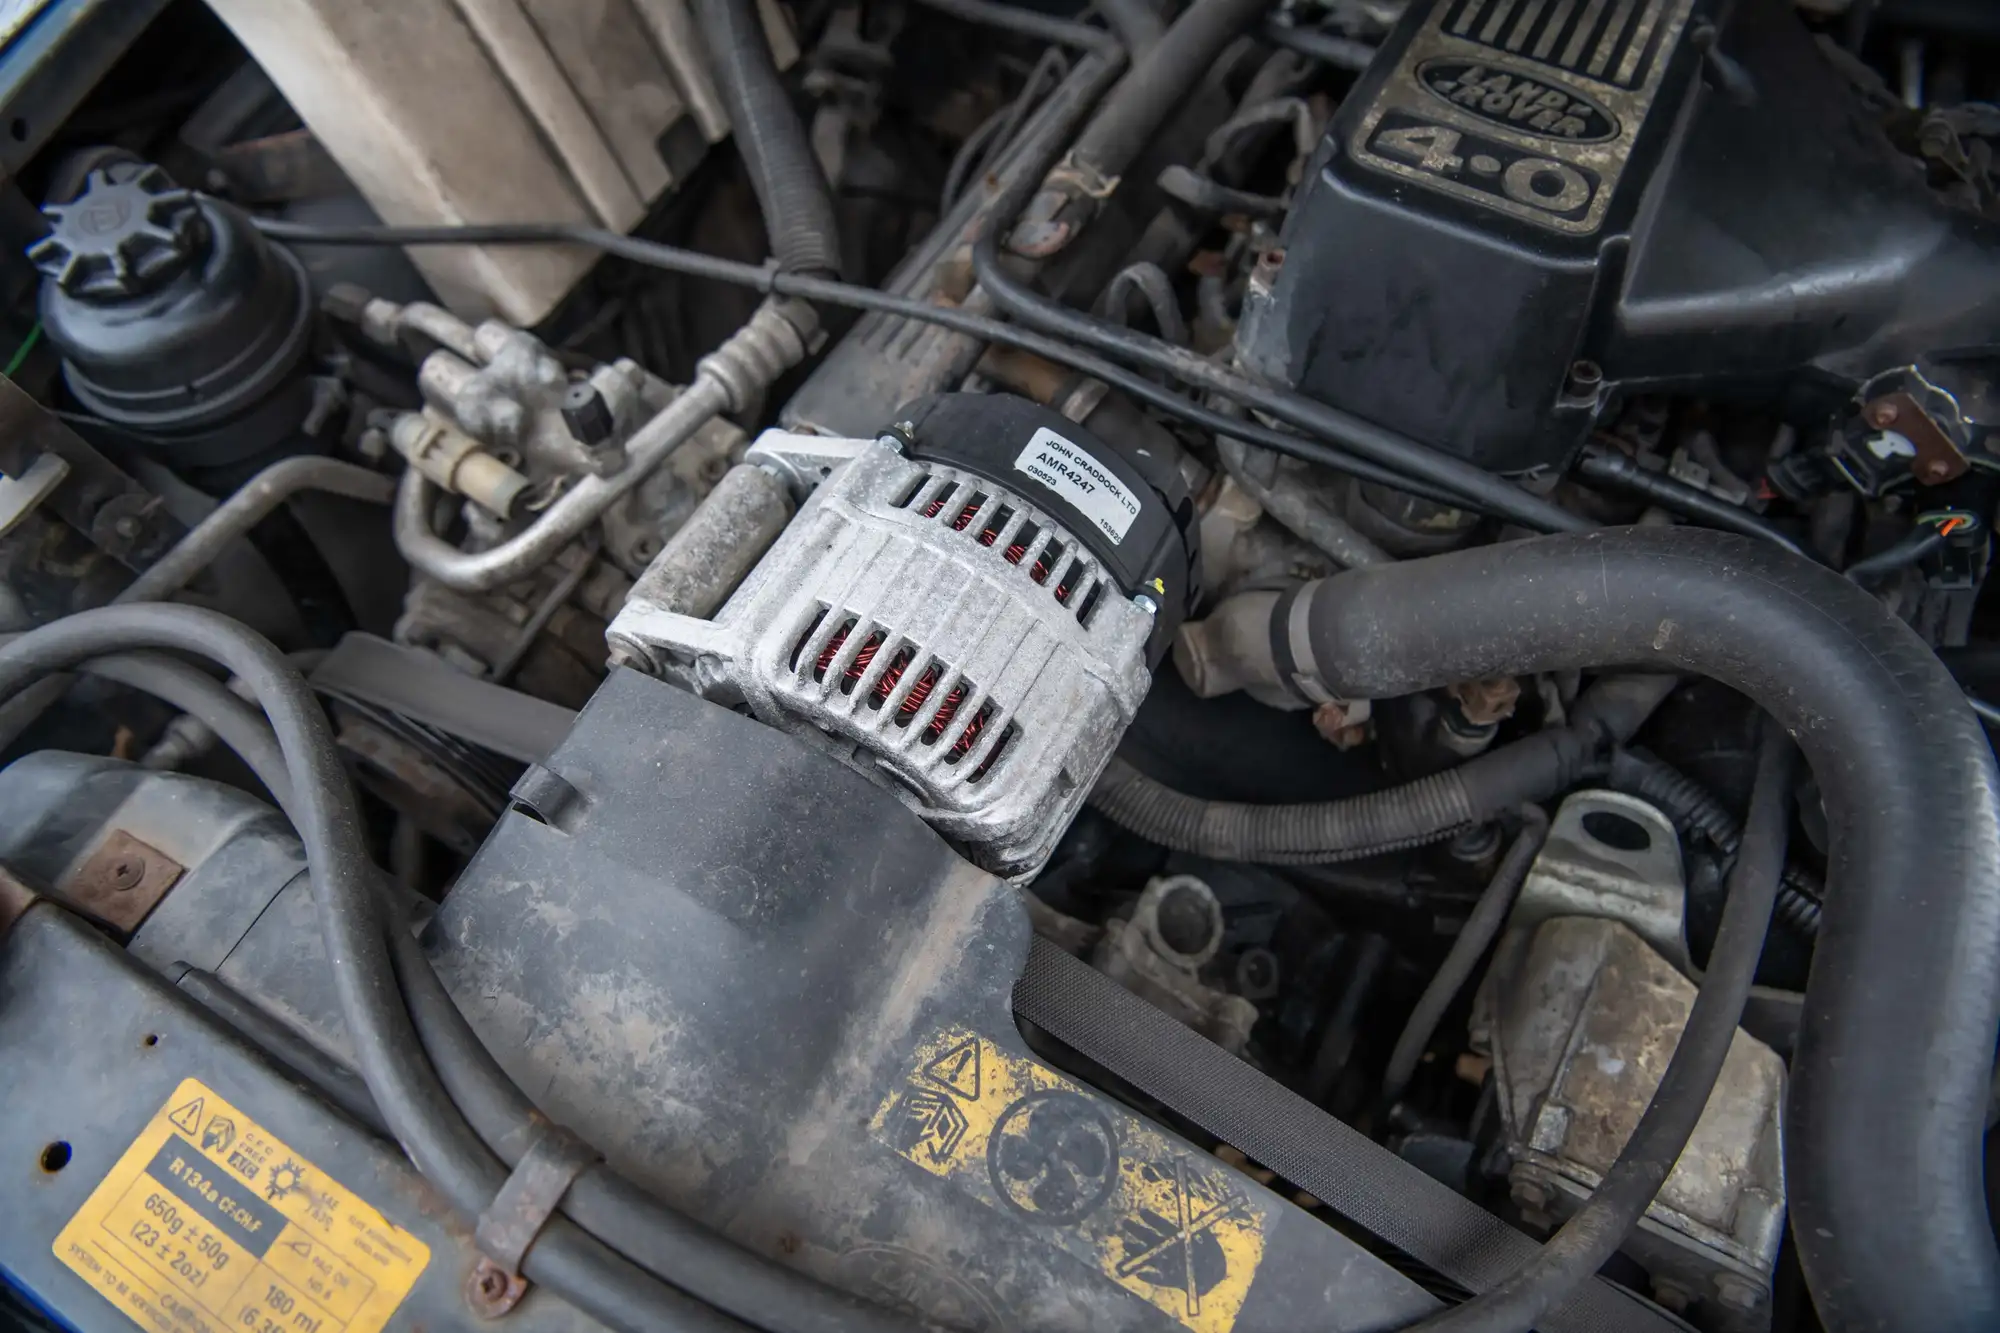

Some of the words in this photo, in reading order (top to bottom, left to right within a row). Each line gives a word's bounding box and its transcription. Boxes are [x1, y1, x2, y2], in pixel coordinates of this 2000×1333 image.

[1450, 84, 1586, 138] ROVER
[1457, 65, 1569, 109] LAND
[1027, 465, 1057, 486] 030523
[1036, 452, 1096, 494] AMR4247
[1045, 440, 1074, 459] JOHN
[1073, 456, 1122, 499] CRADDOCK
[1121, 496, 1137, 515] LTD
[130, 1218, 160, 1248] (23
[170, 1251, 210, 1288] 2oz)
[145, 1193, 184, 1235] 650g
[197, 1233, 230, 1270] 50g
[264, 1285, 295, 1316] 180
